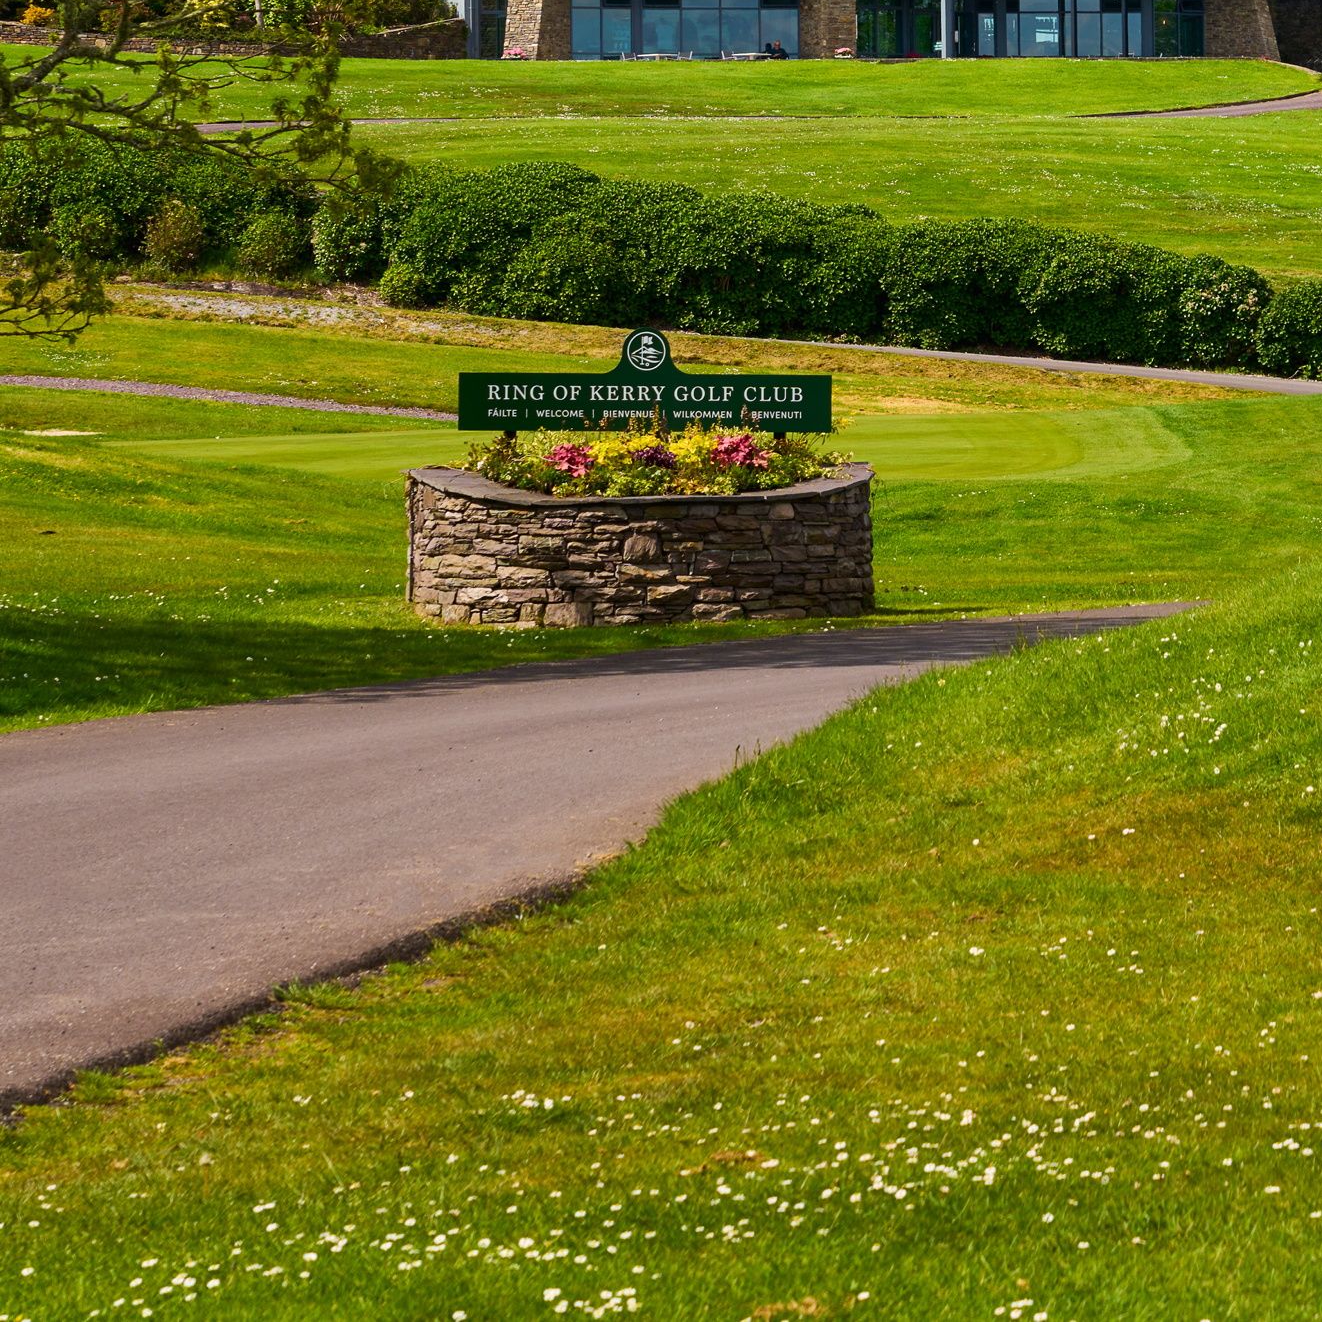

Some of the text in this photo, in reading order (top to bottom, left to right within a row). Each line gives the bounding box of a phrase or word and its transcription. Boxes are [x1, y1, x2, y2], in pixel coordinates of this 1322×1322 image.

[488, 384, 804, 403] RING OF KERRY GOLF CLUB
[488, 407, 518, 418] FÁILTE
[536, 409, 585, 418] WELCOME
[603, 410, 655, 419] BIENVENUE
[751, 411, 802, 420] BENVENUTI
